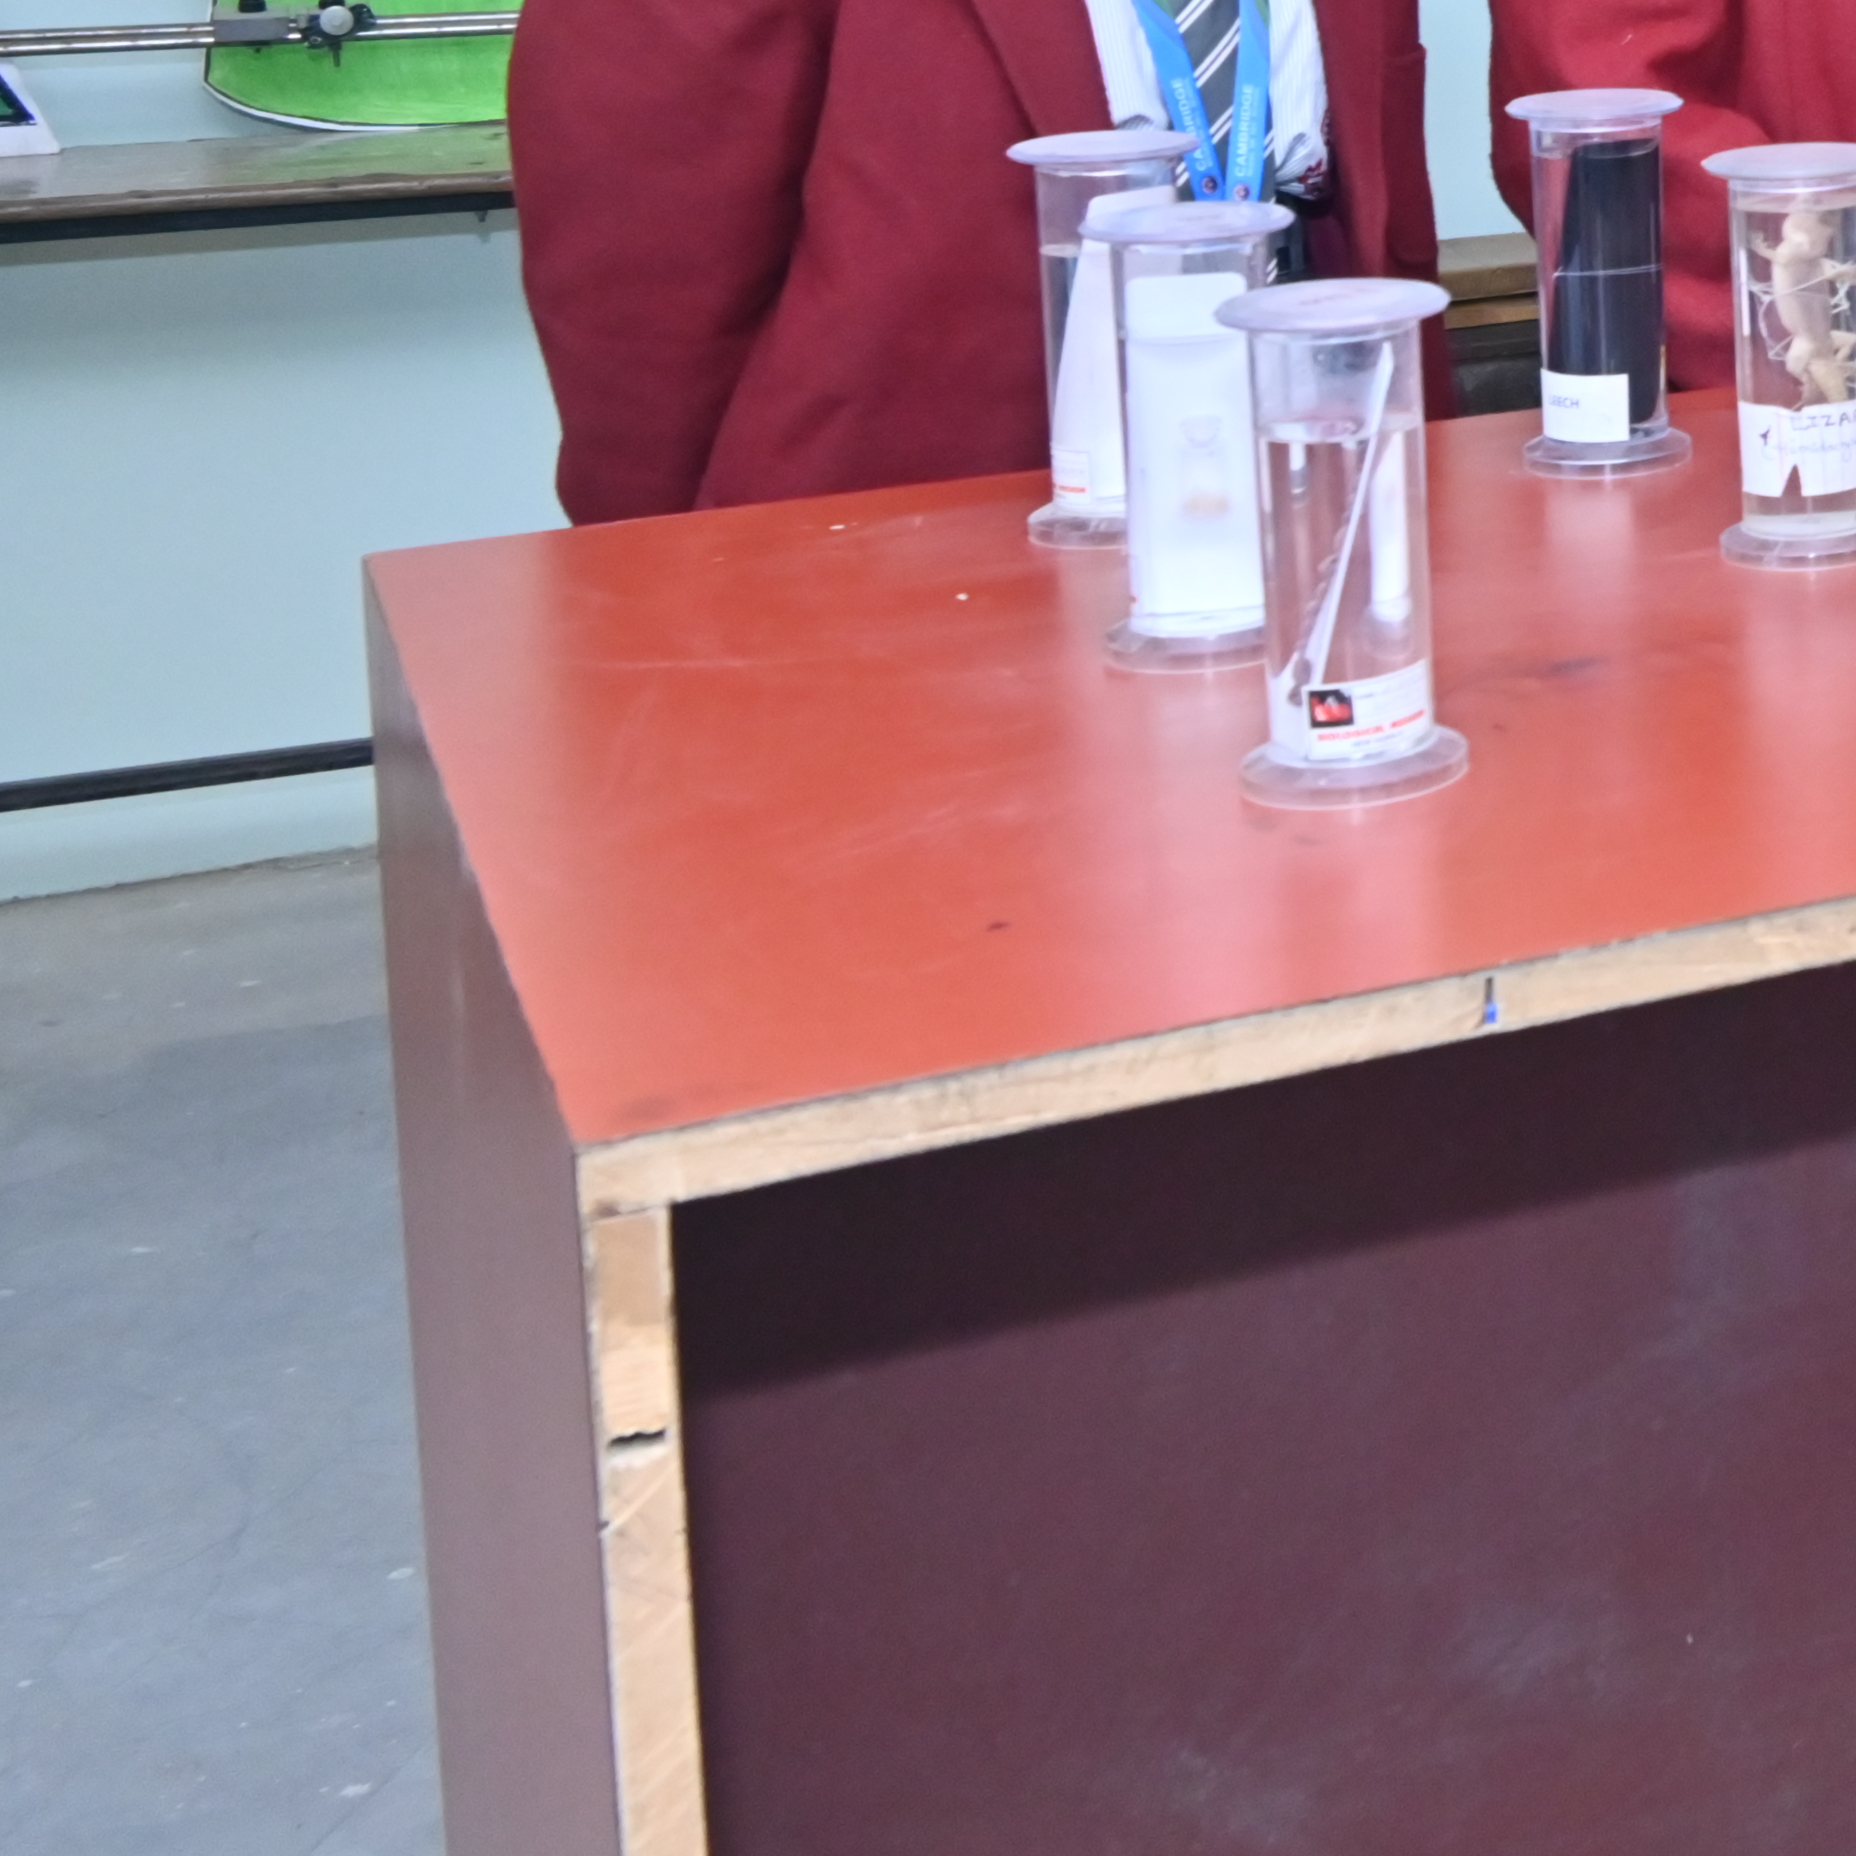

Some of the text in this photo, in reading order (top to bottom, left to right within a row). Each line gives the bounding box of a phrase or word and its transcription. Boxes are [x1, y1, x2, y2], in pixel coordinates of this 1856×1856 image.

[1171, 76, 1207, 171] CABRIDGE
[1235, 84, 1254, 177] CAMBRIDGE
[1548, 395, 1580, 410] LEECH
